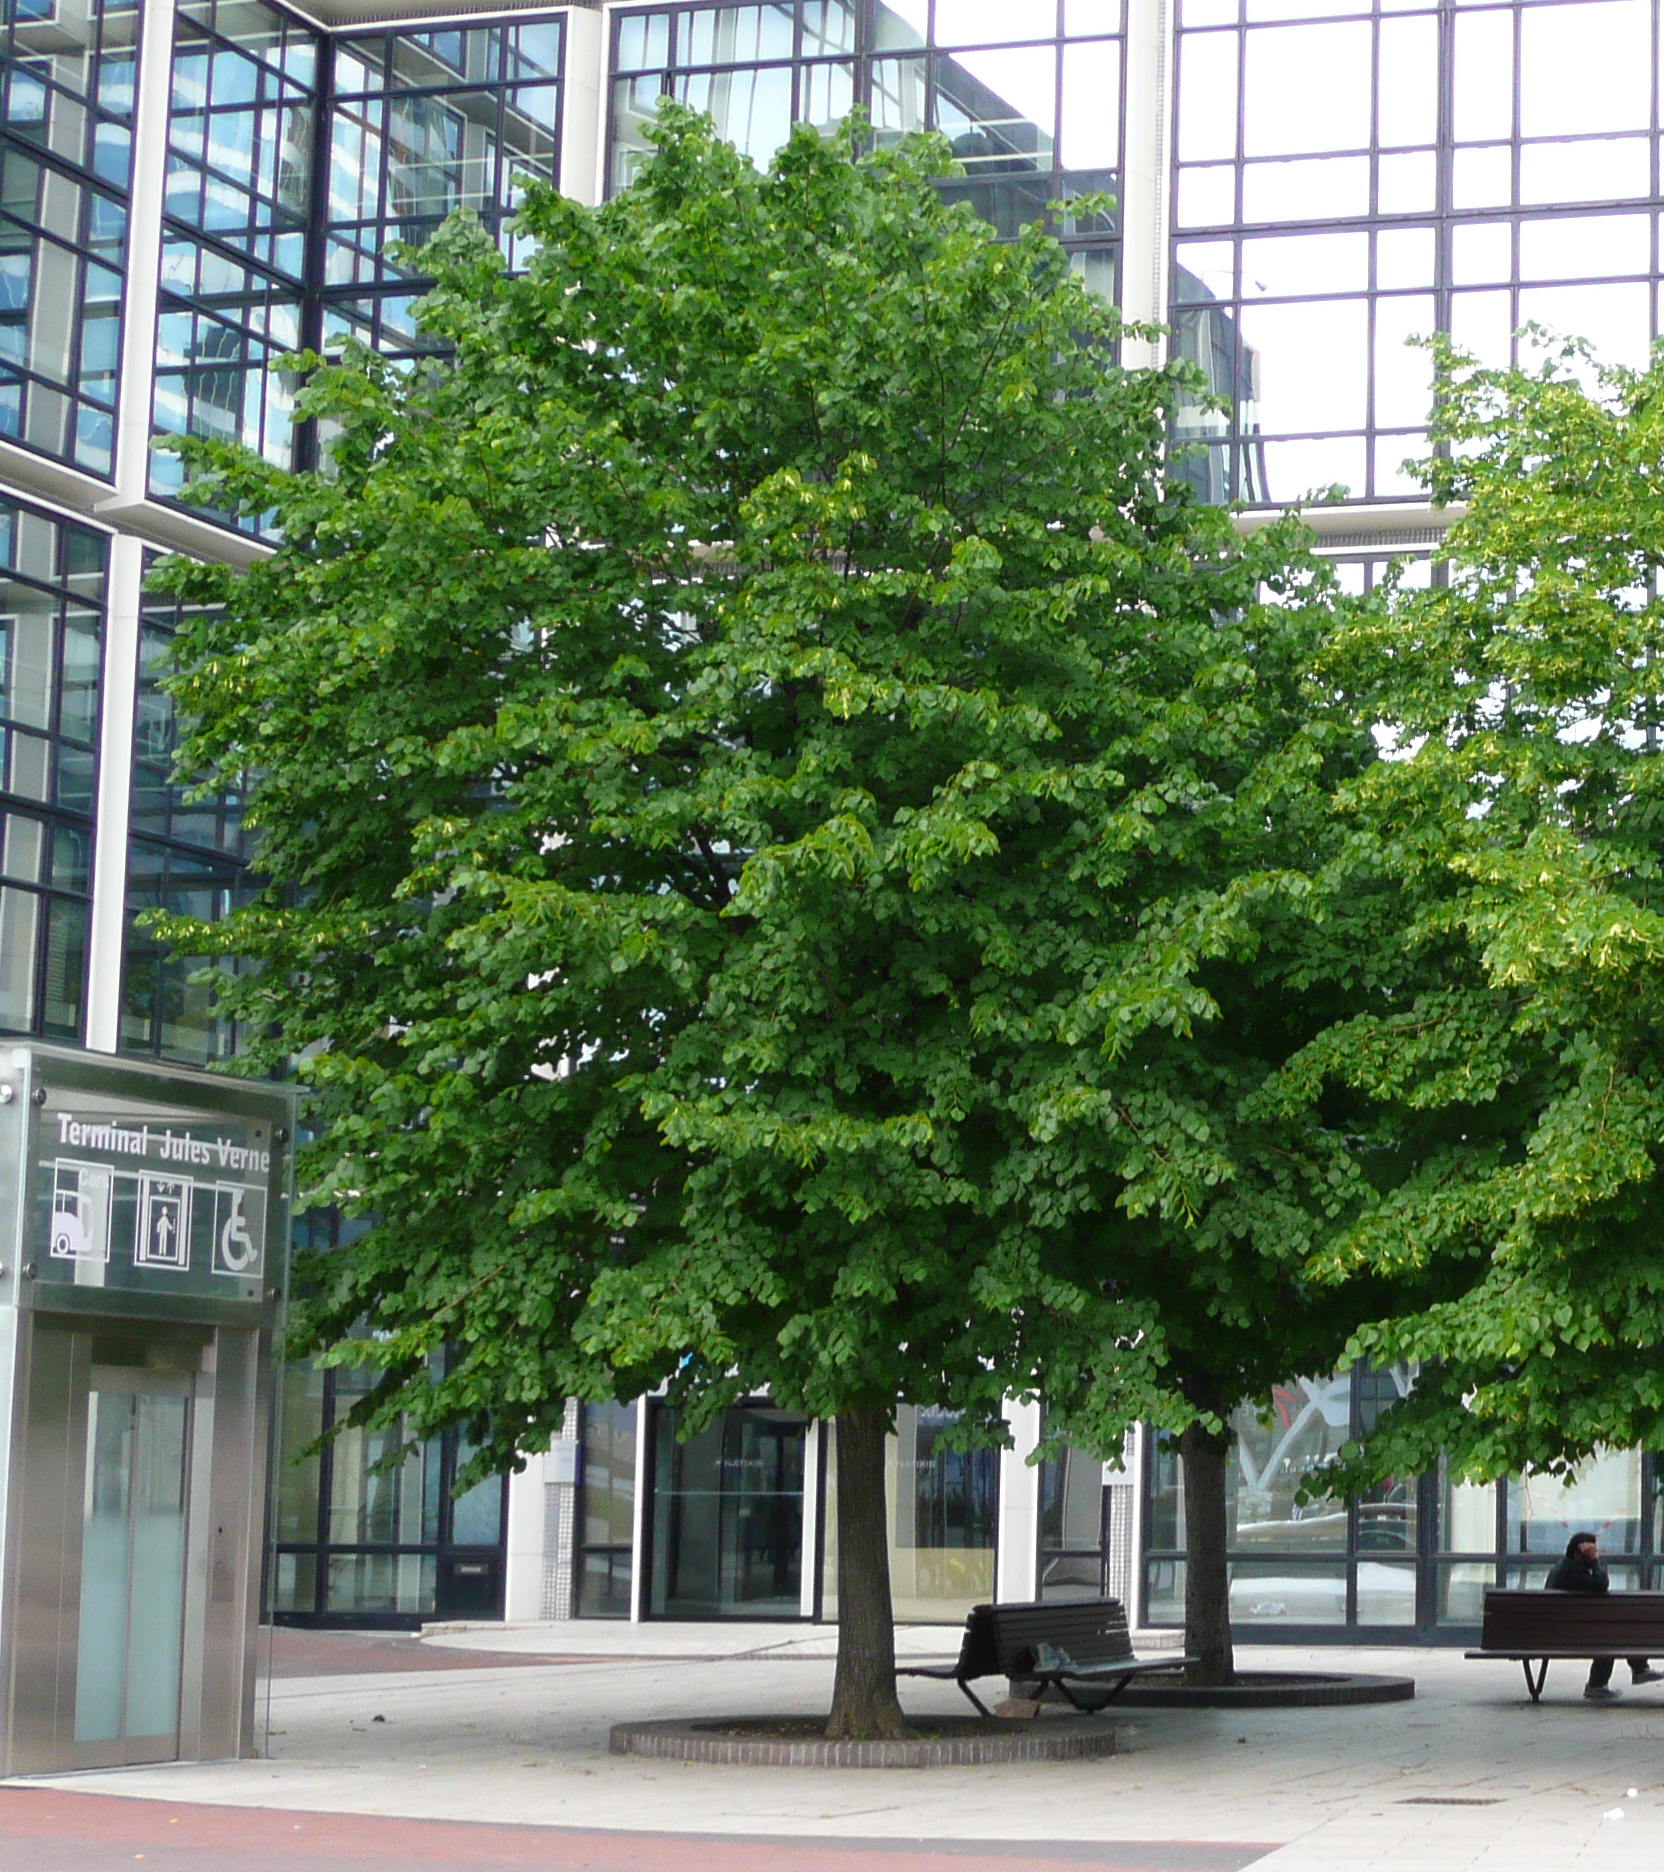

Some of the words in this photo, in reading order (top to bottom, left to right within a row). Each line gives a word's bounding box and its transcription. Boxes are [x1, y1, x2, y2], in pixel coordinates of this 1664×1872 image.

[57, 1112, 147, 1156] Terminal
[160, 1129, 210, 1165] Jules
[217, 1136, 270, 1173] Verne
